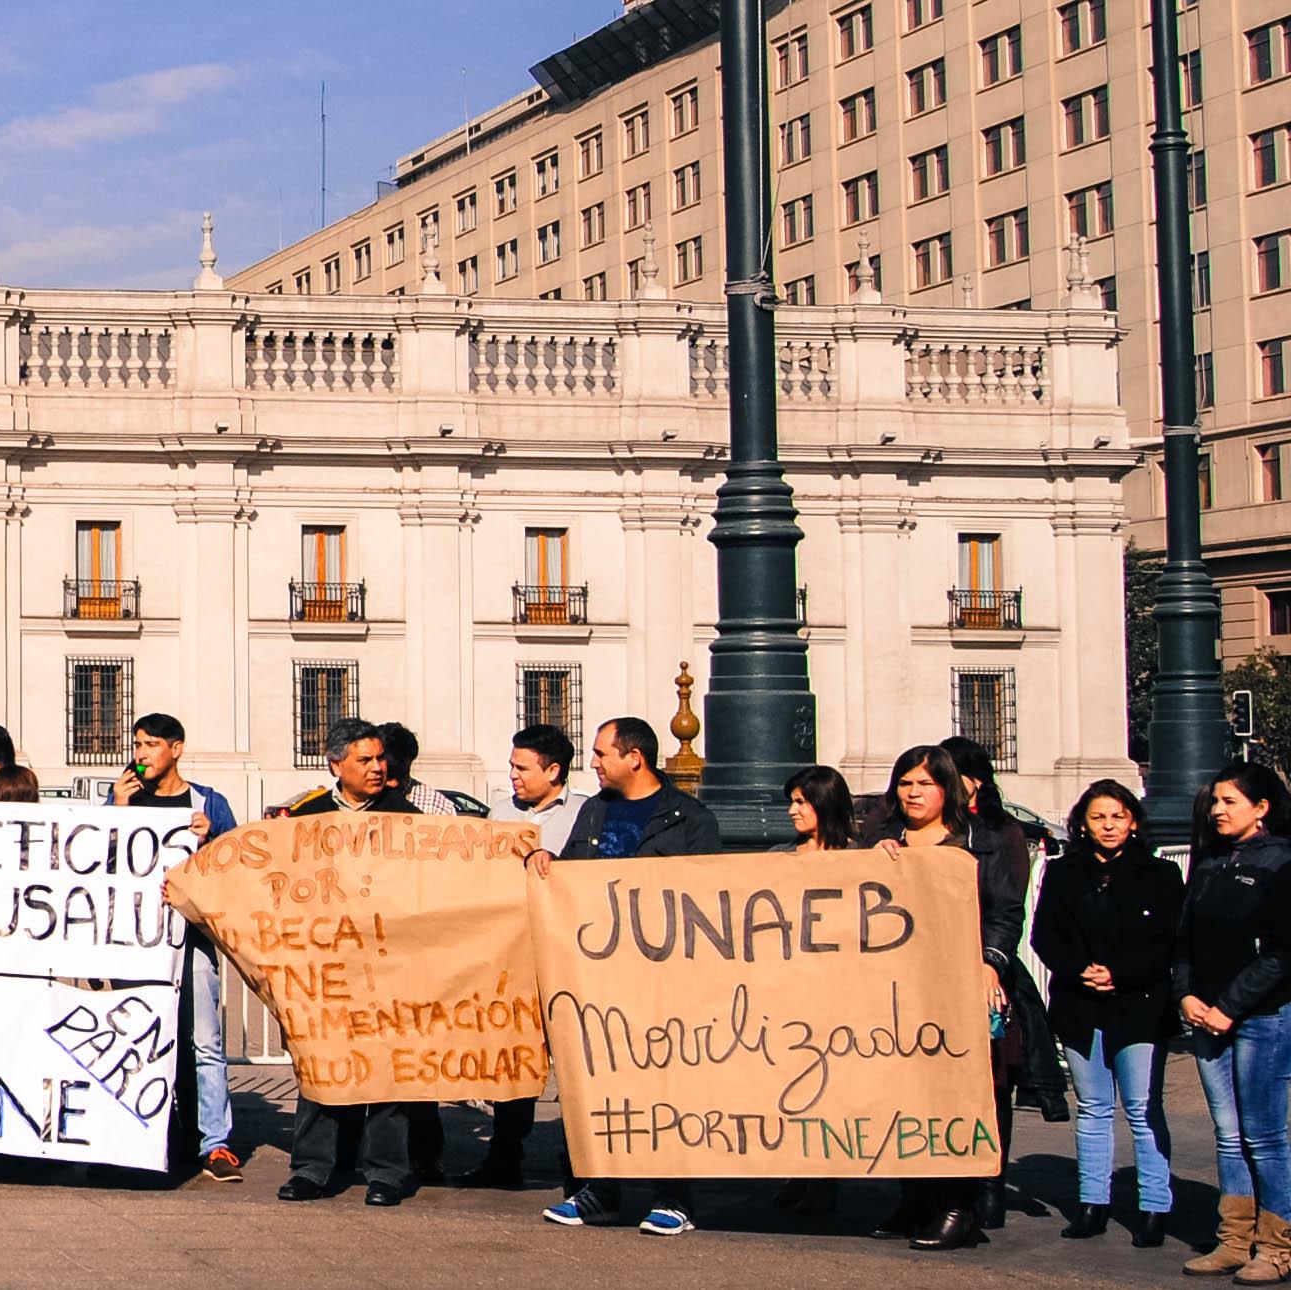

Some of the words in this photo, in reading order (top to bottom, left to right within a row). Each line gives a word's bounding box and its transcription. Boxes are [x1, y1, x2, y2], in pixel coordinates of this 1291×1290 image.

[184, 828, 272, 877] NOS
[576, 878, 915, 963] JUNAEB
[43, 1005, 169, 1120] PARO
[106, 997, 175, 1064] EN
[549, 981, 970, 1115] Movilizada
